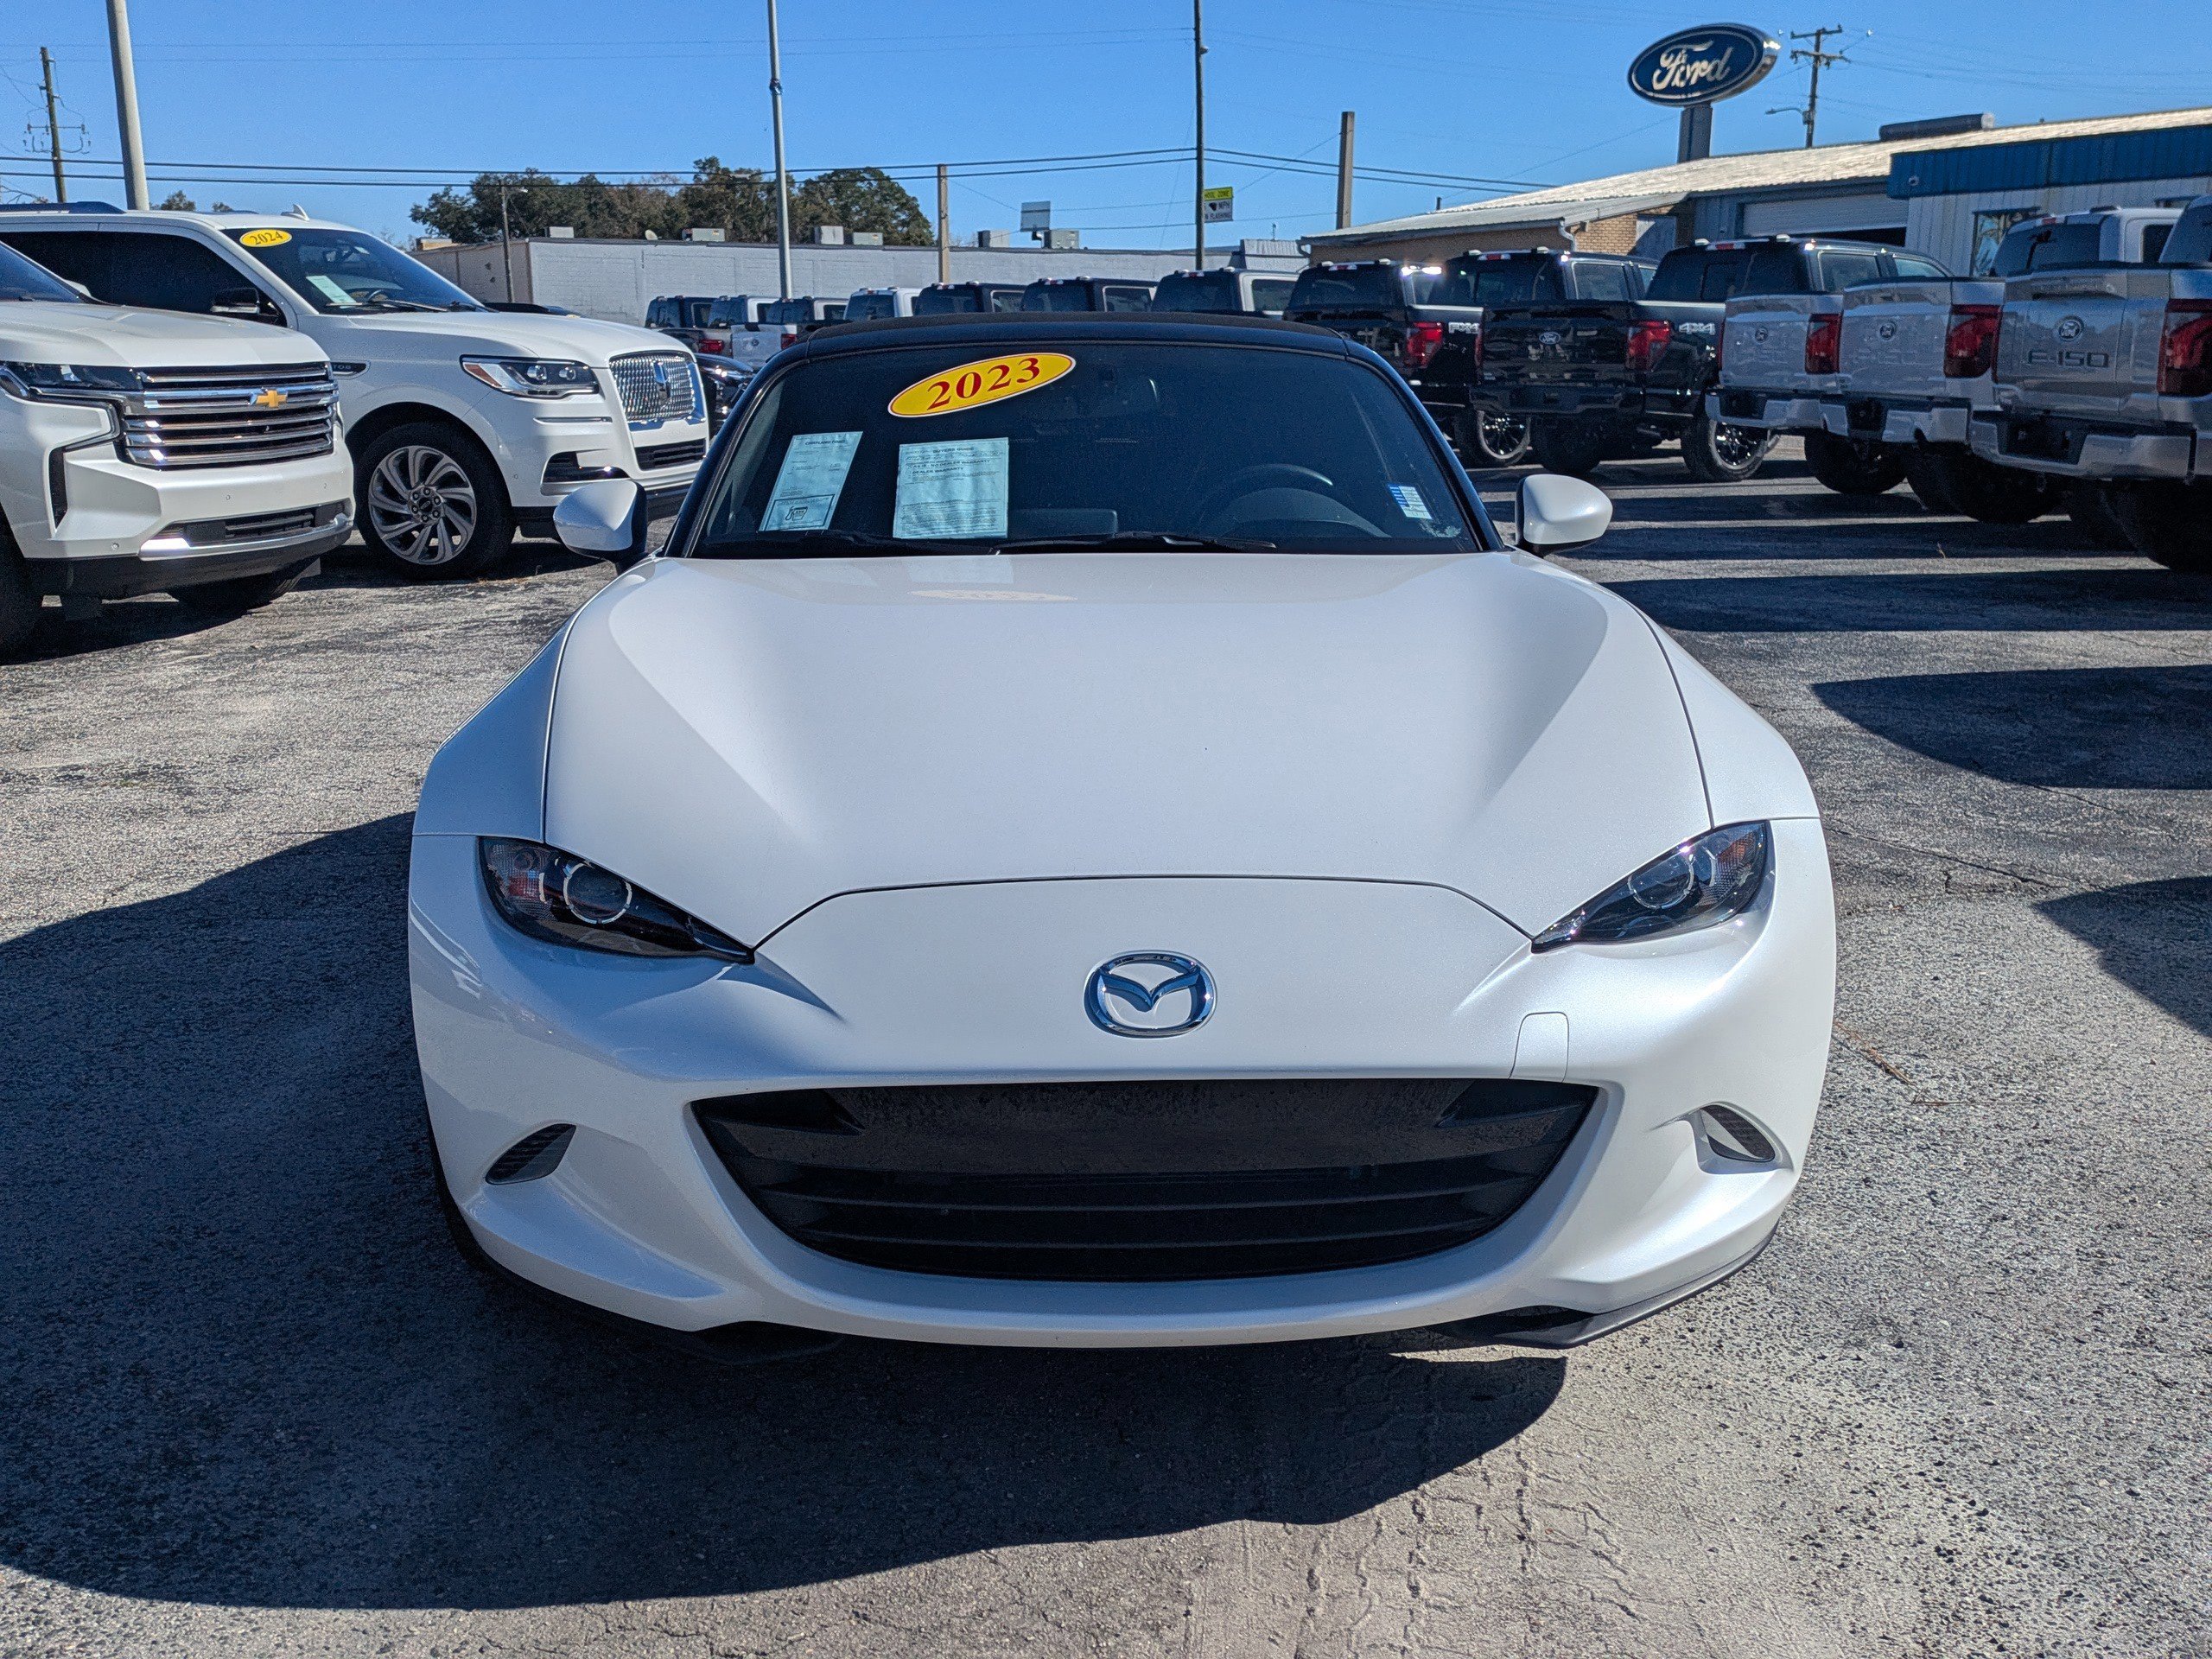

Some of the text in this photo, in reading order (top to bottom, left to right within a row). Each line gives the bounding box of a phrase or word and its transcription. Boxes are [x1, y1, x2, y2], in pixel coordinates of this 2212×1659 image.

[1652, 40, 1734, 91] Ford
[249, 231, 283, 245] 2024
[2028, 351, 2109, 367] F-150
[926, 357, 1041, 411] 2023
